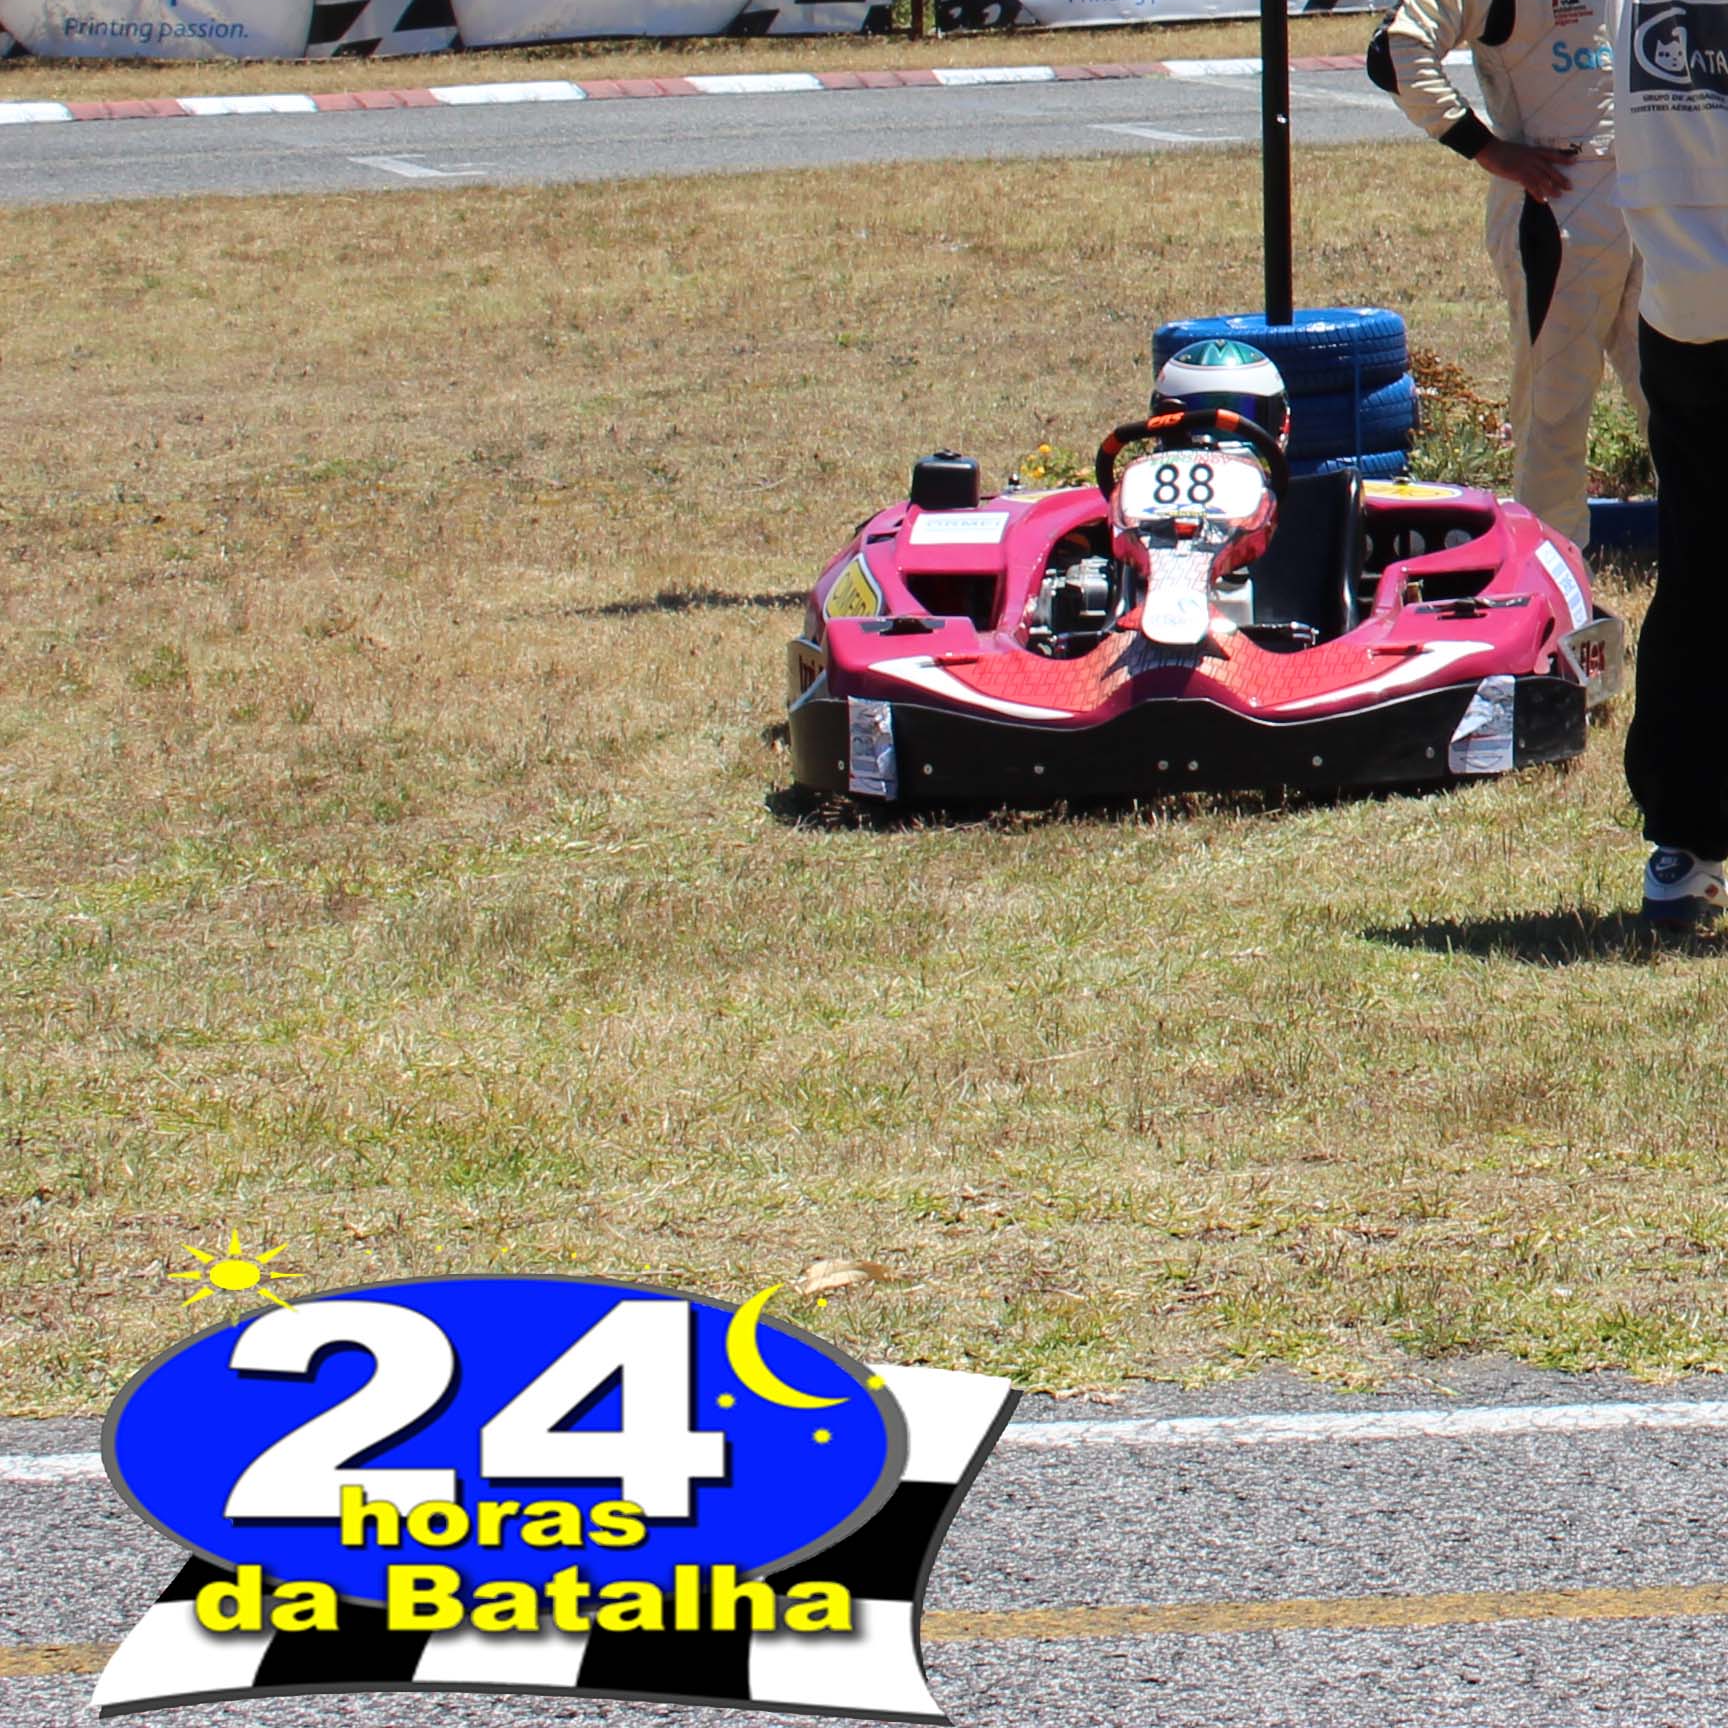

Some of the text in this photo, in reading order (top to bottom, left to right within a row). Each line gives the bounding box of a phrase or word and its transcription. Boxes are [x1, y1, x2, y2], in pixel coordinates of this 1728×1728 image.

[63, 16, 250, 44] Printing passion.
[1153, 463, 1214, 504] 88
